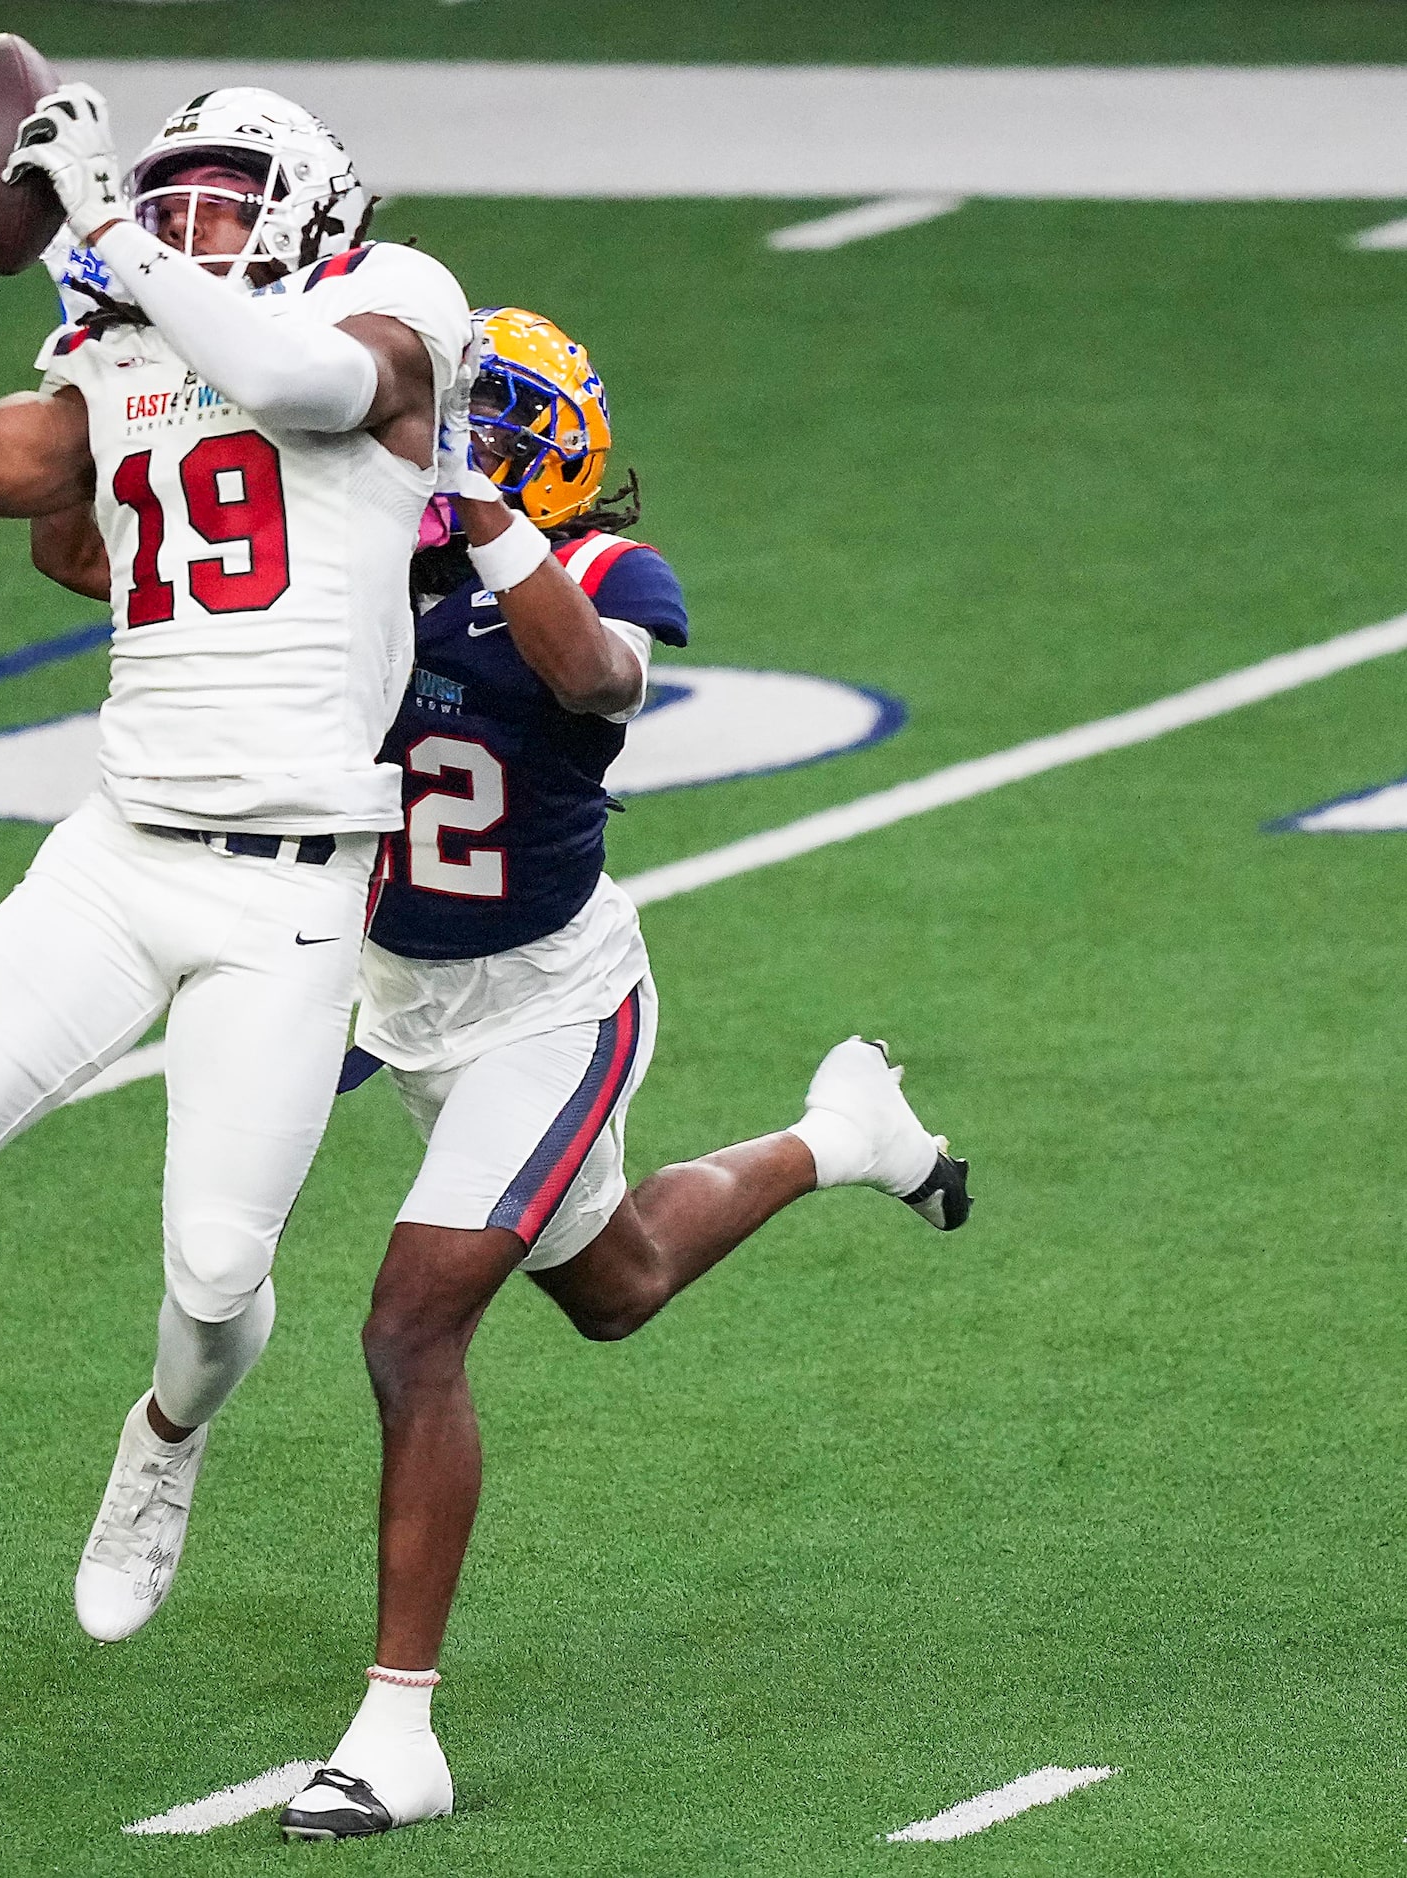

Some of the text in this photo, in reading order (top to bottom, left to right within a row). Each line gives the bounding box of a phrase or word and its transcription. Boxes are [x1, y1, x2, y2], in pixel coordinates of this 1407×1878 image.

[126, 392, 171, 421] EAST
[112, 429, 291, 630] 19
[374, 731, 508, 900] 2
